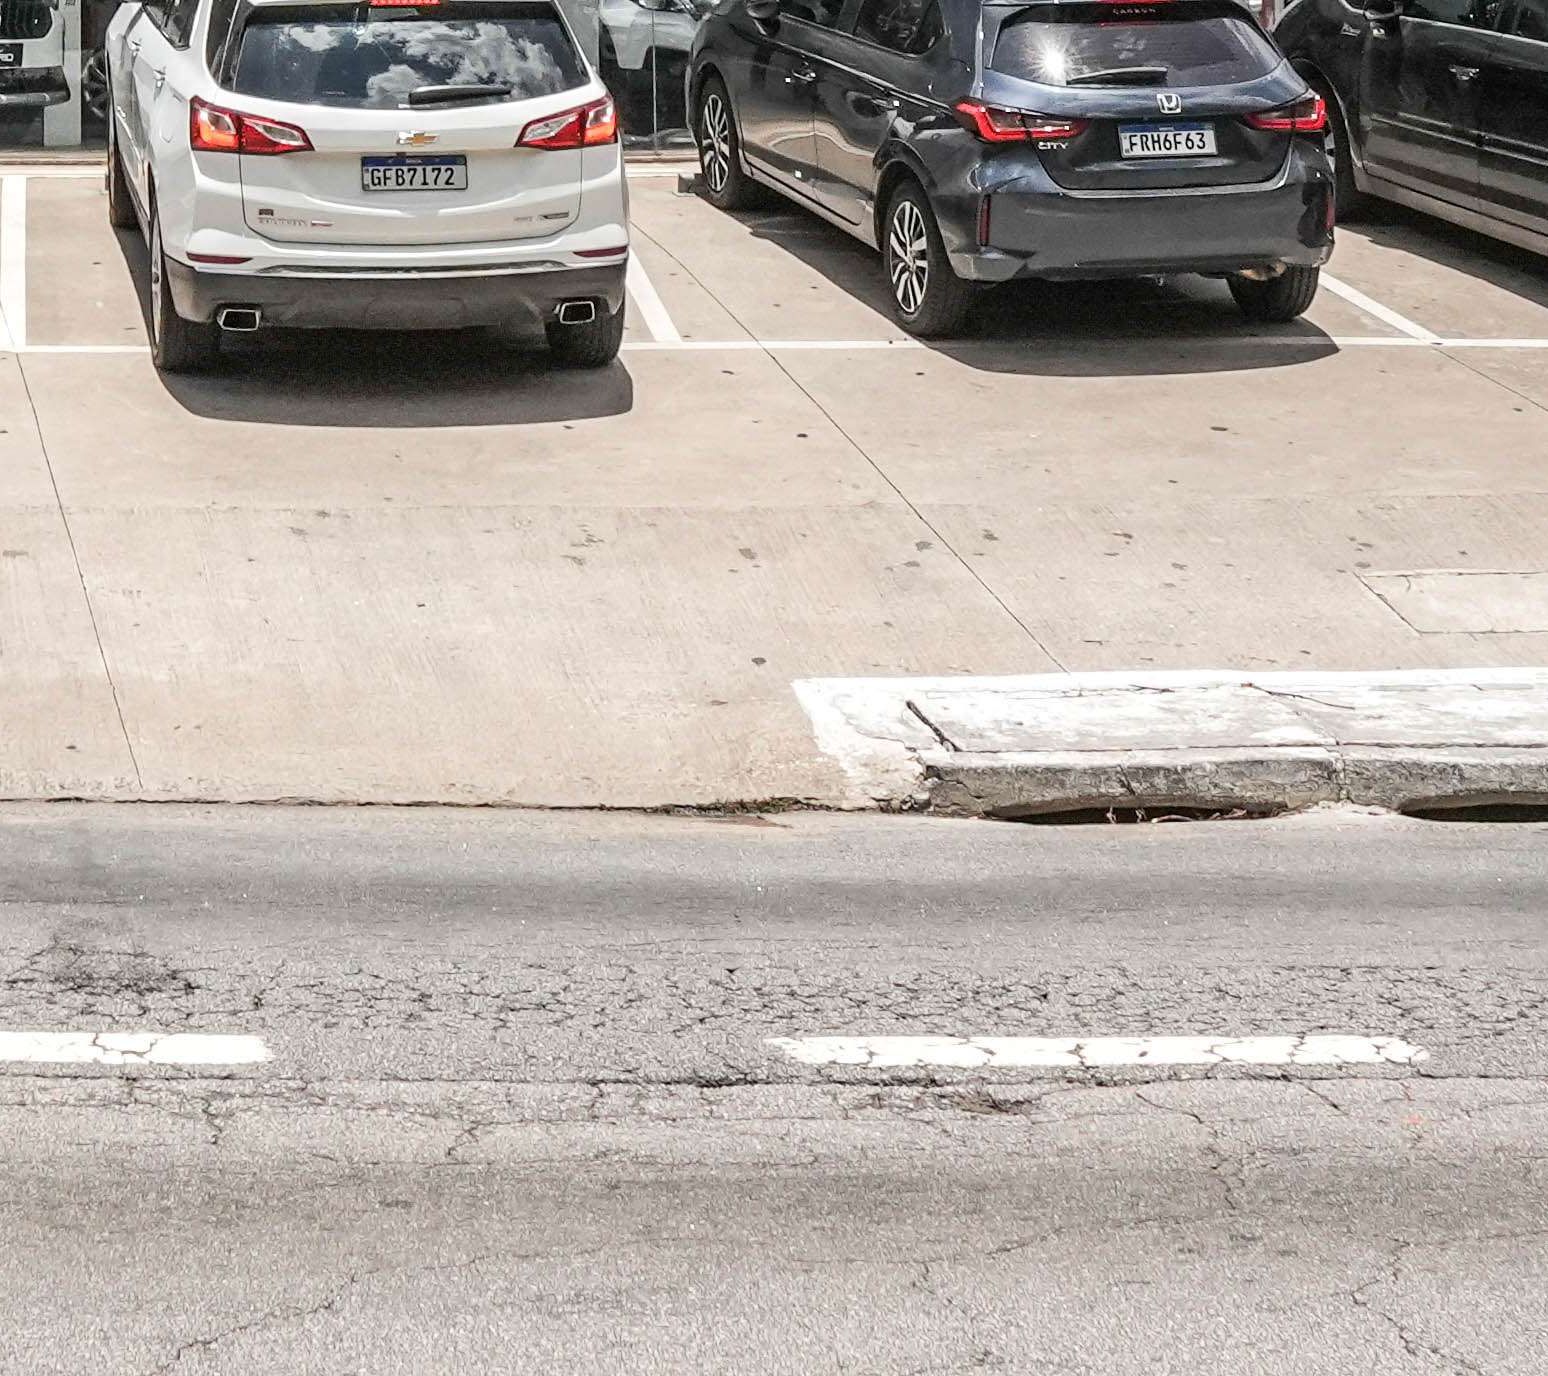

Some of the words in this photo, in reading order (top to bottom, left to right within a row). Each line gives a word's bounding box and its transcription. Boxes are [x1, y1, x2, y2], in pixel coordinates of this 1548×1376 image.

[1038, 140, 1069, 150] CITY
[1129, 132, 1207, 152] FRH6F63
[370, 167, 455, 186] GFB7172
